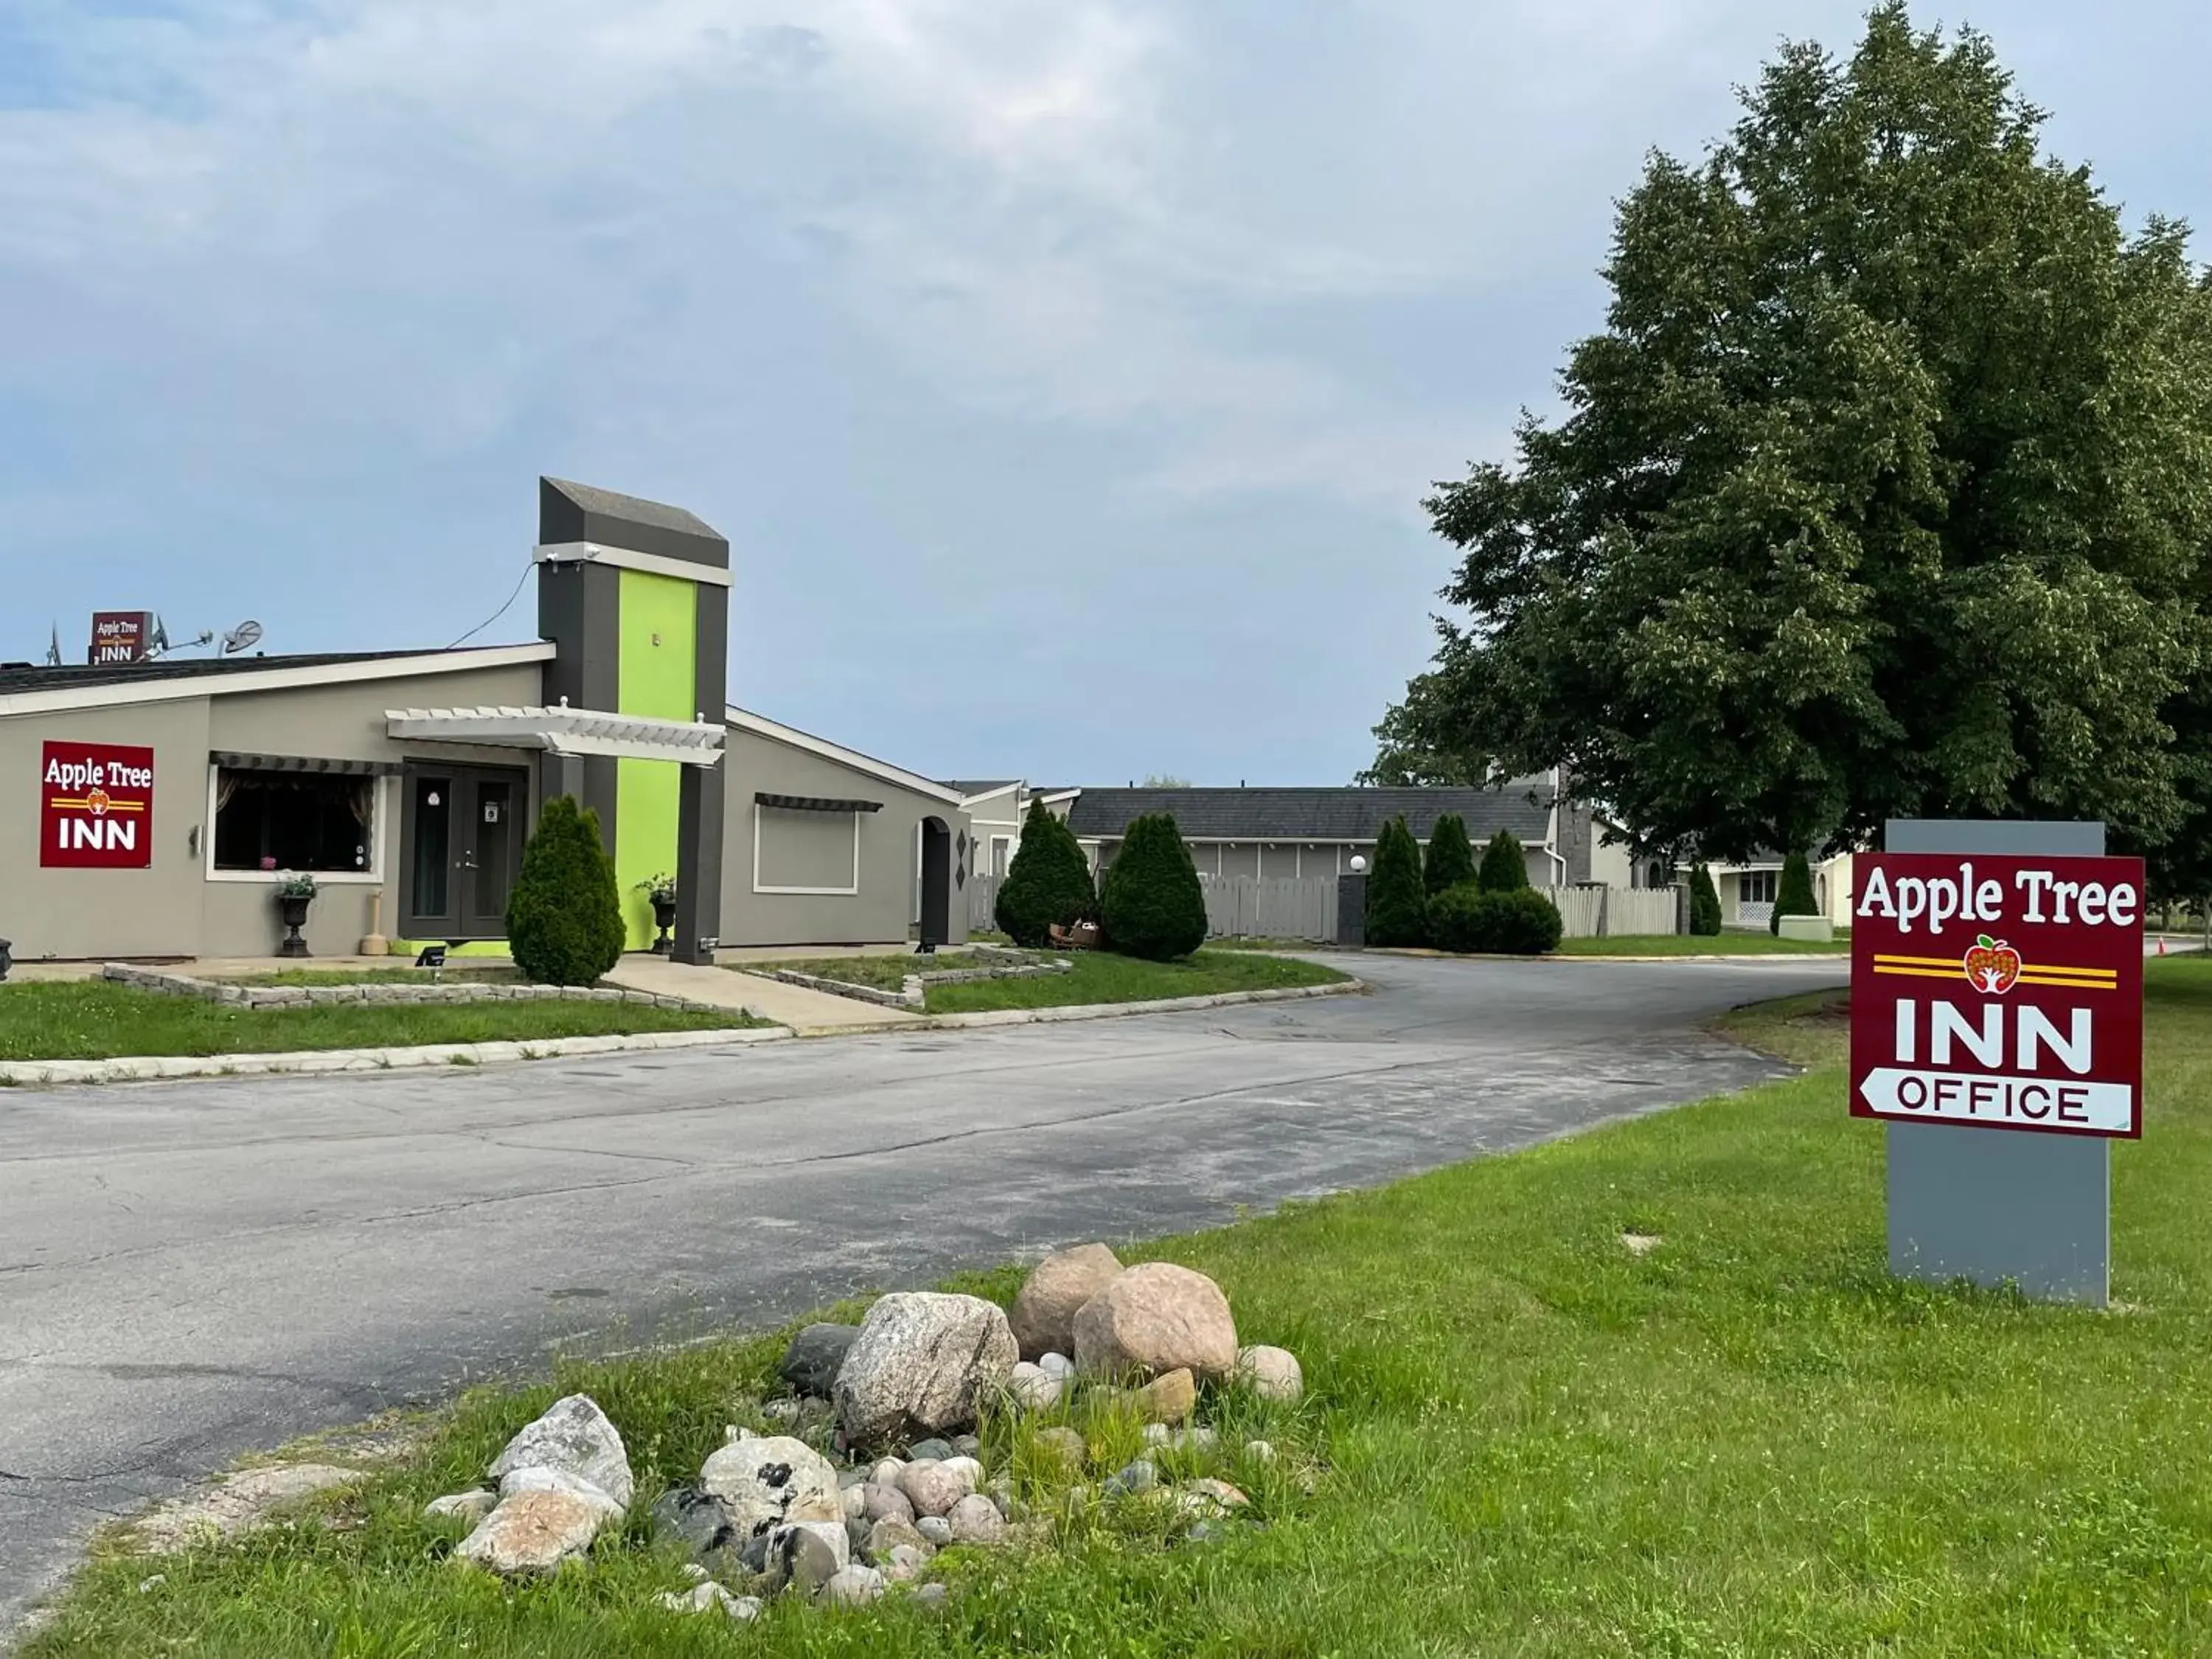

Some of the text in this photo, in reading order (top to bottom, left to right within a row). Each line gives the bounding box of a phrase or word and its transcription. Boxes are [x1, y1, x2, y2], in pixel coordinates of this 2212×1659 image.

[97, 620, 138, 636] Apple Tree
[101, 647, 132, 661] INN
[44, 757, 152, 790] Apple Tree
[59, 818, 136, 850] INN
[1857, 863, 2136, 933] Apple Tree
[1896, 999, 2092, 1074] INN
[1897, 1077, 2089, 1122] OFFICE
